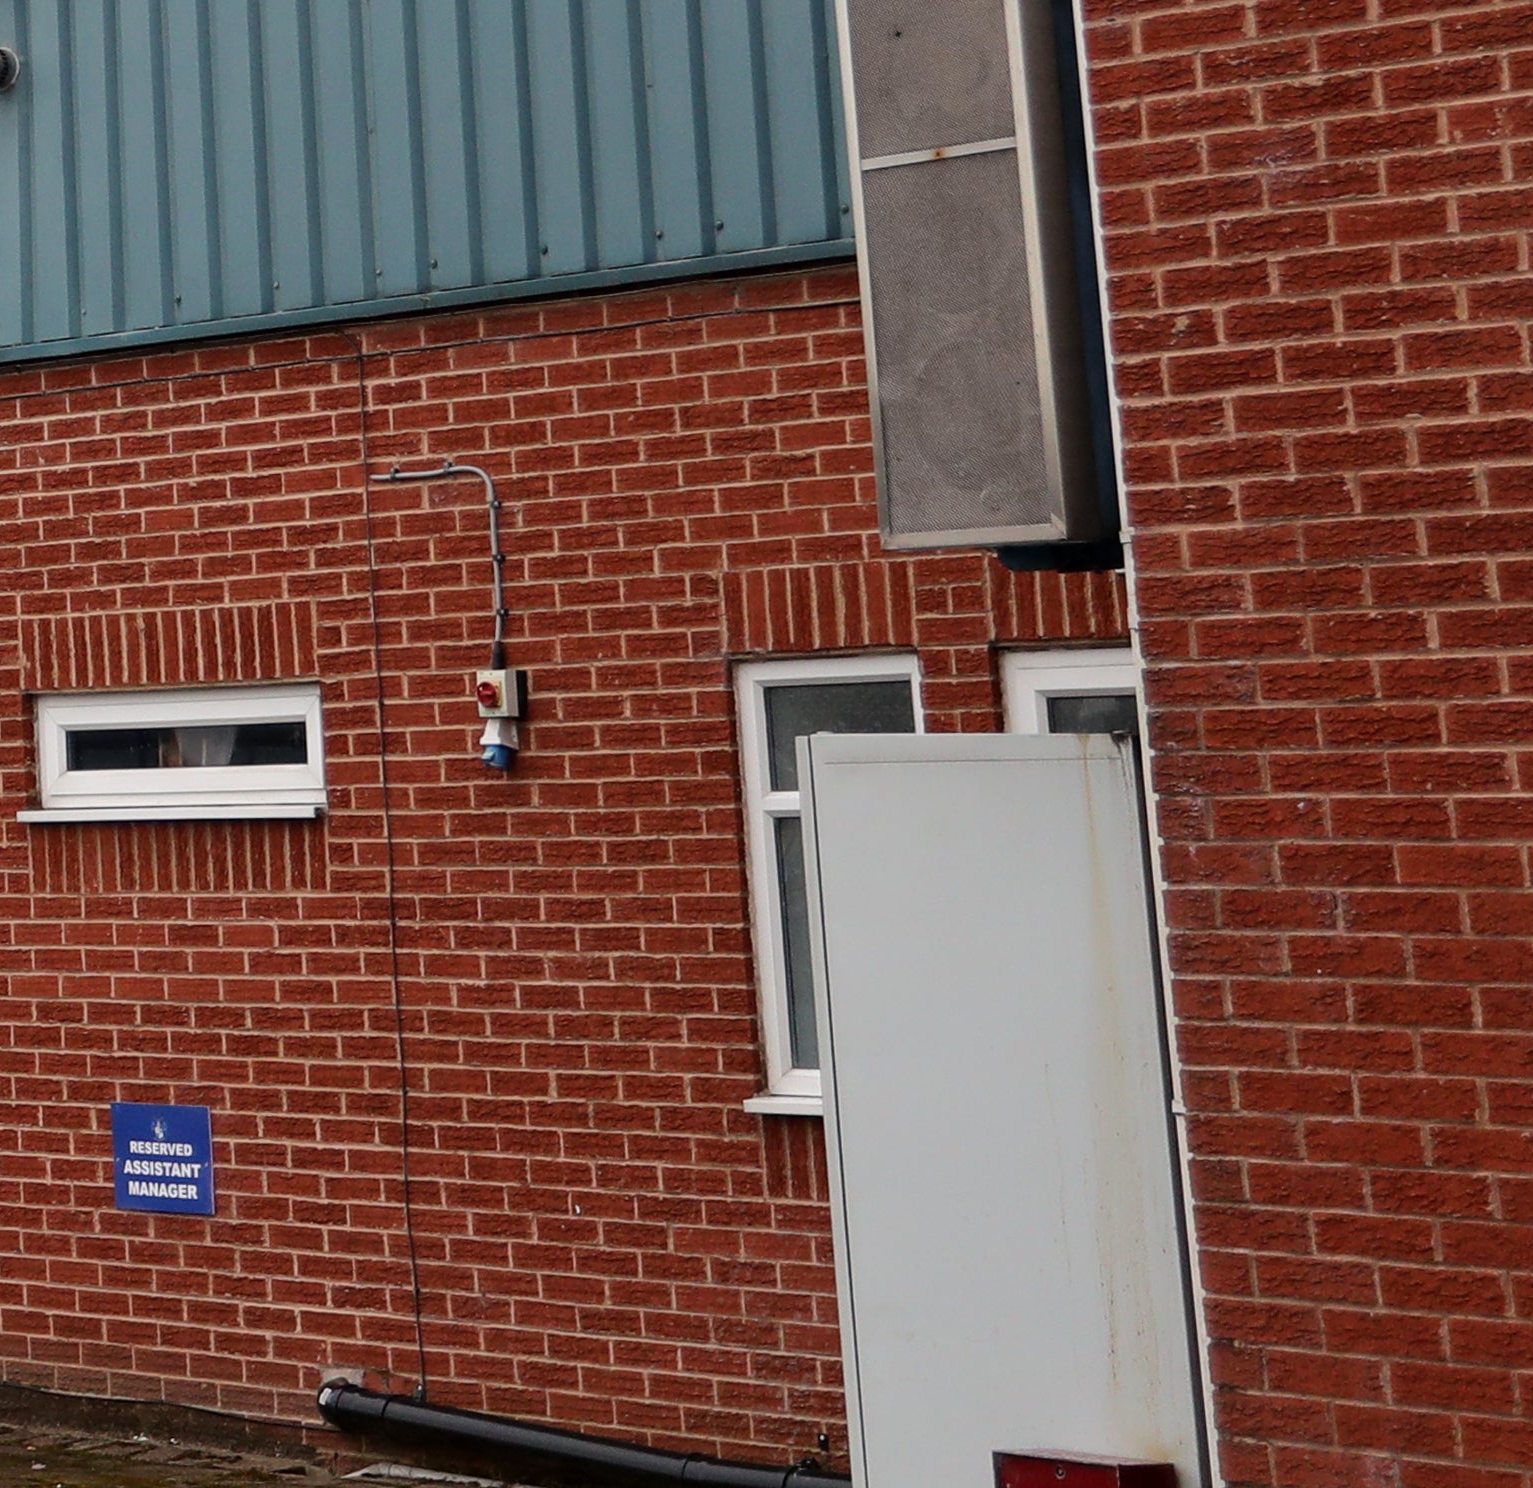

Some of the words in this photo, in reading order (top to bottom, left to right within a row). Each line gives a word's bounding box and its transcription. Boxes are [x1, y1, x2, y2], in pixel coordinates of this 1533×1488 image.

[129, 1140, 193, 1157] RESERVED
[123, 1159, 202, 1179] ASSISTANT
[128, 1181, 199, 1200] MANAGER
